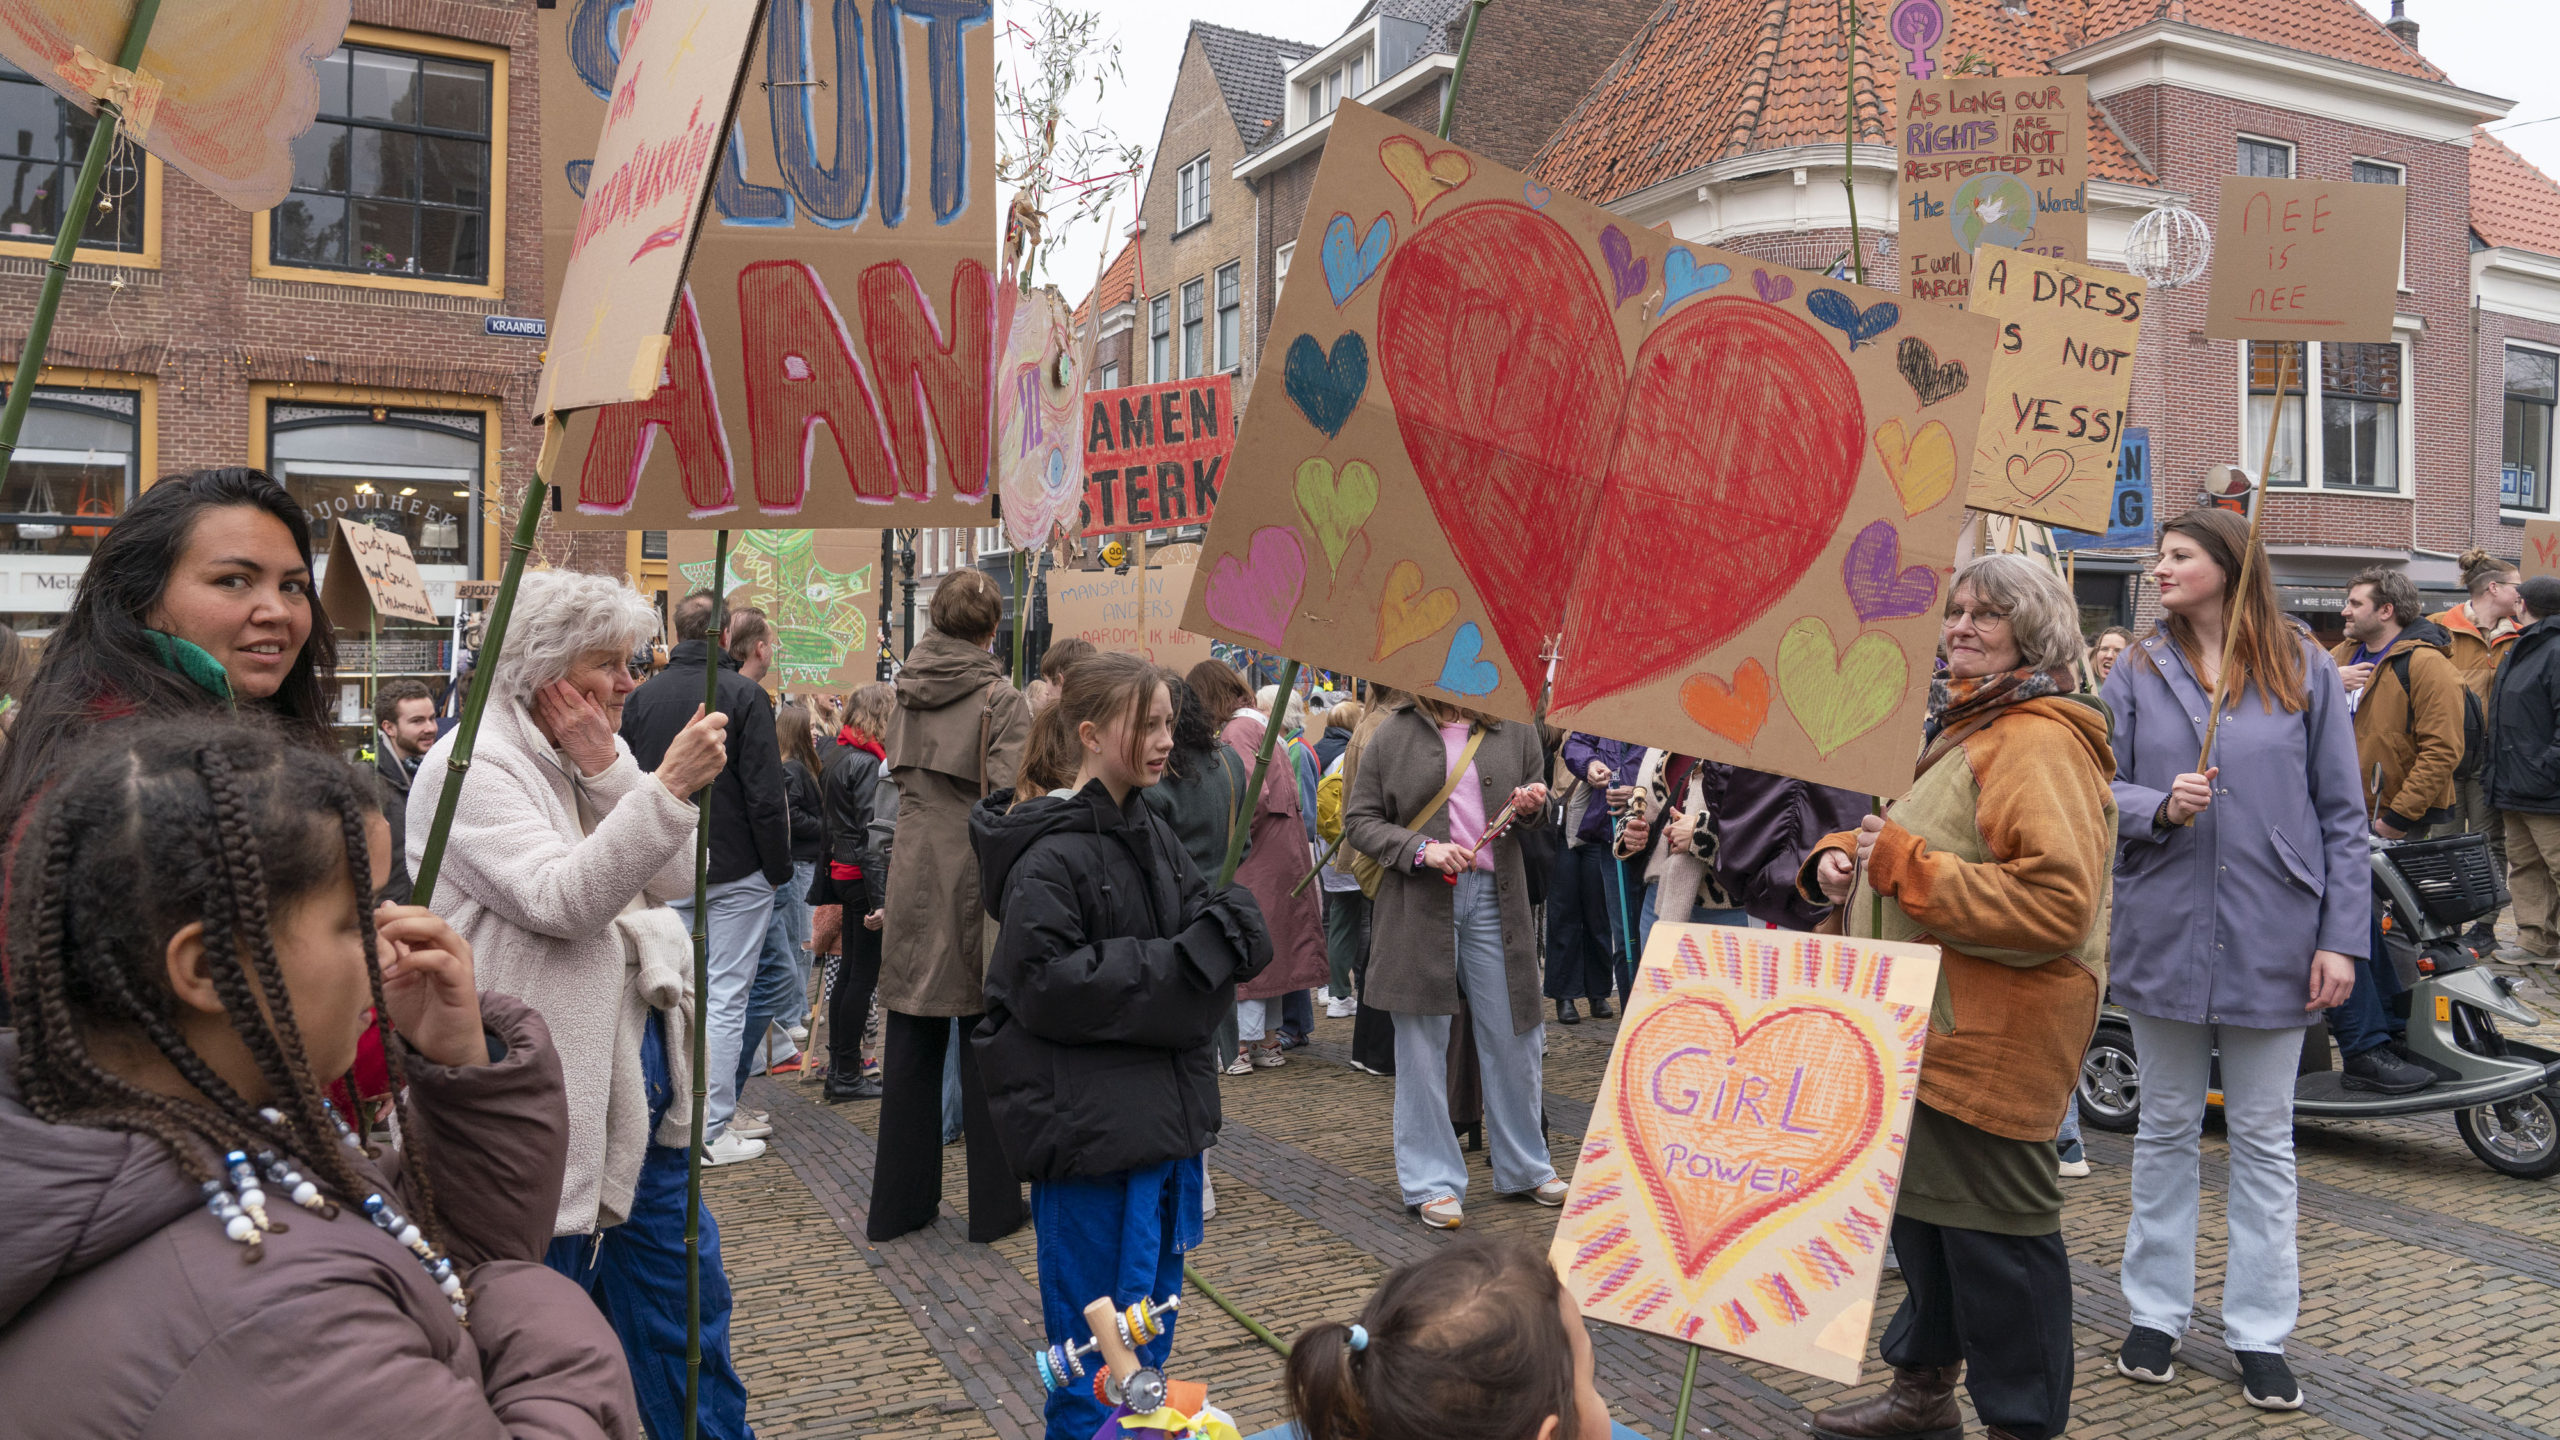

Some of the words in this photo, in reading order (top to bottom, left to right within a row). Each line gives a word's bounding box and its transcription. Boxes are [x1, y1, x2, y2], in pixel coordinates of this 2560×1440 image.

[1907, 88, 1942, 120] AS
[2014, 85, 2065, 110] OUR
[2013, 116, 2051, 132] ARE
[2012, 130, 2065, 154] NOT
[1904, 155, 2033, 183] RESPECTED
[2037, 158, 2065, 178] IN
[1911, 253, 1928, 275] I
[1988, 260, 2007, 294] A
[2032, 270, 2142, 324] DRESS
[2061, 336, 2132, 376] NOT
[1662, 1143, 1802, 1195] POWER
